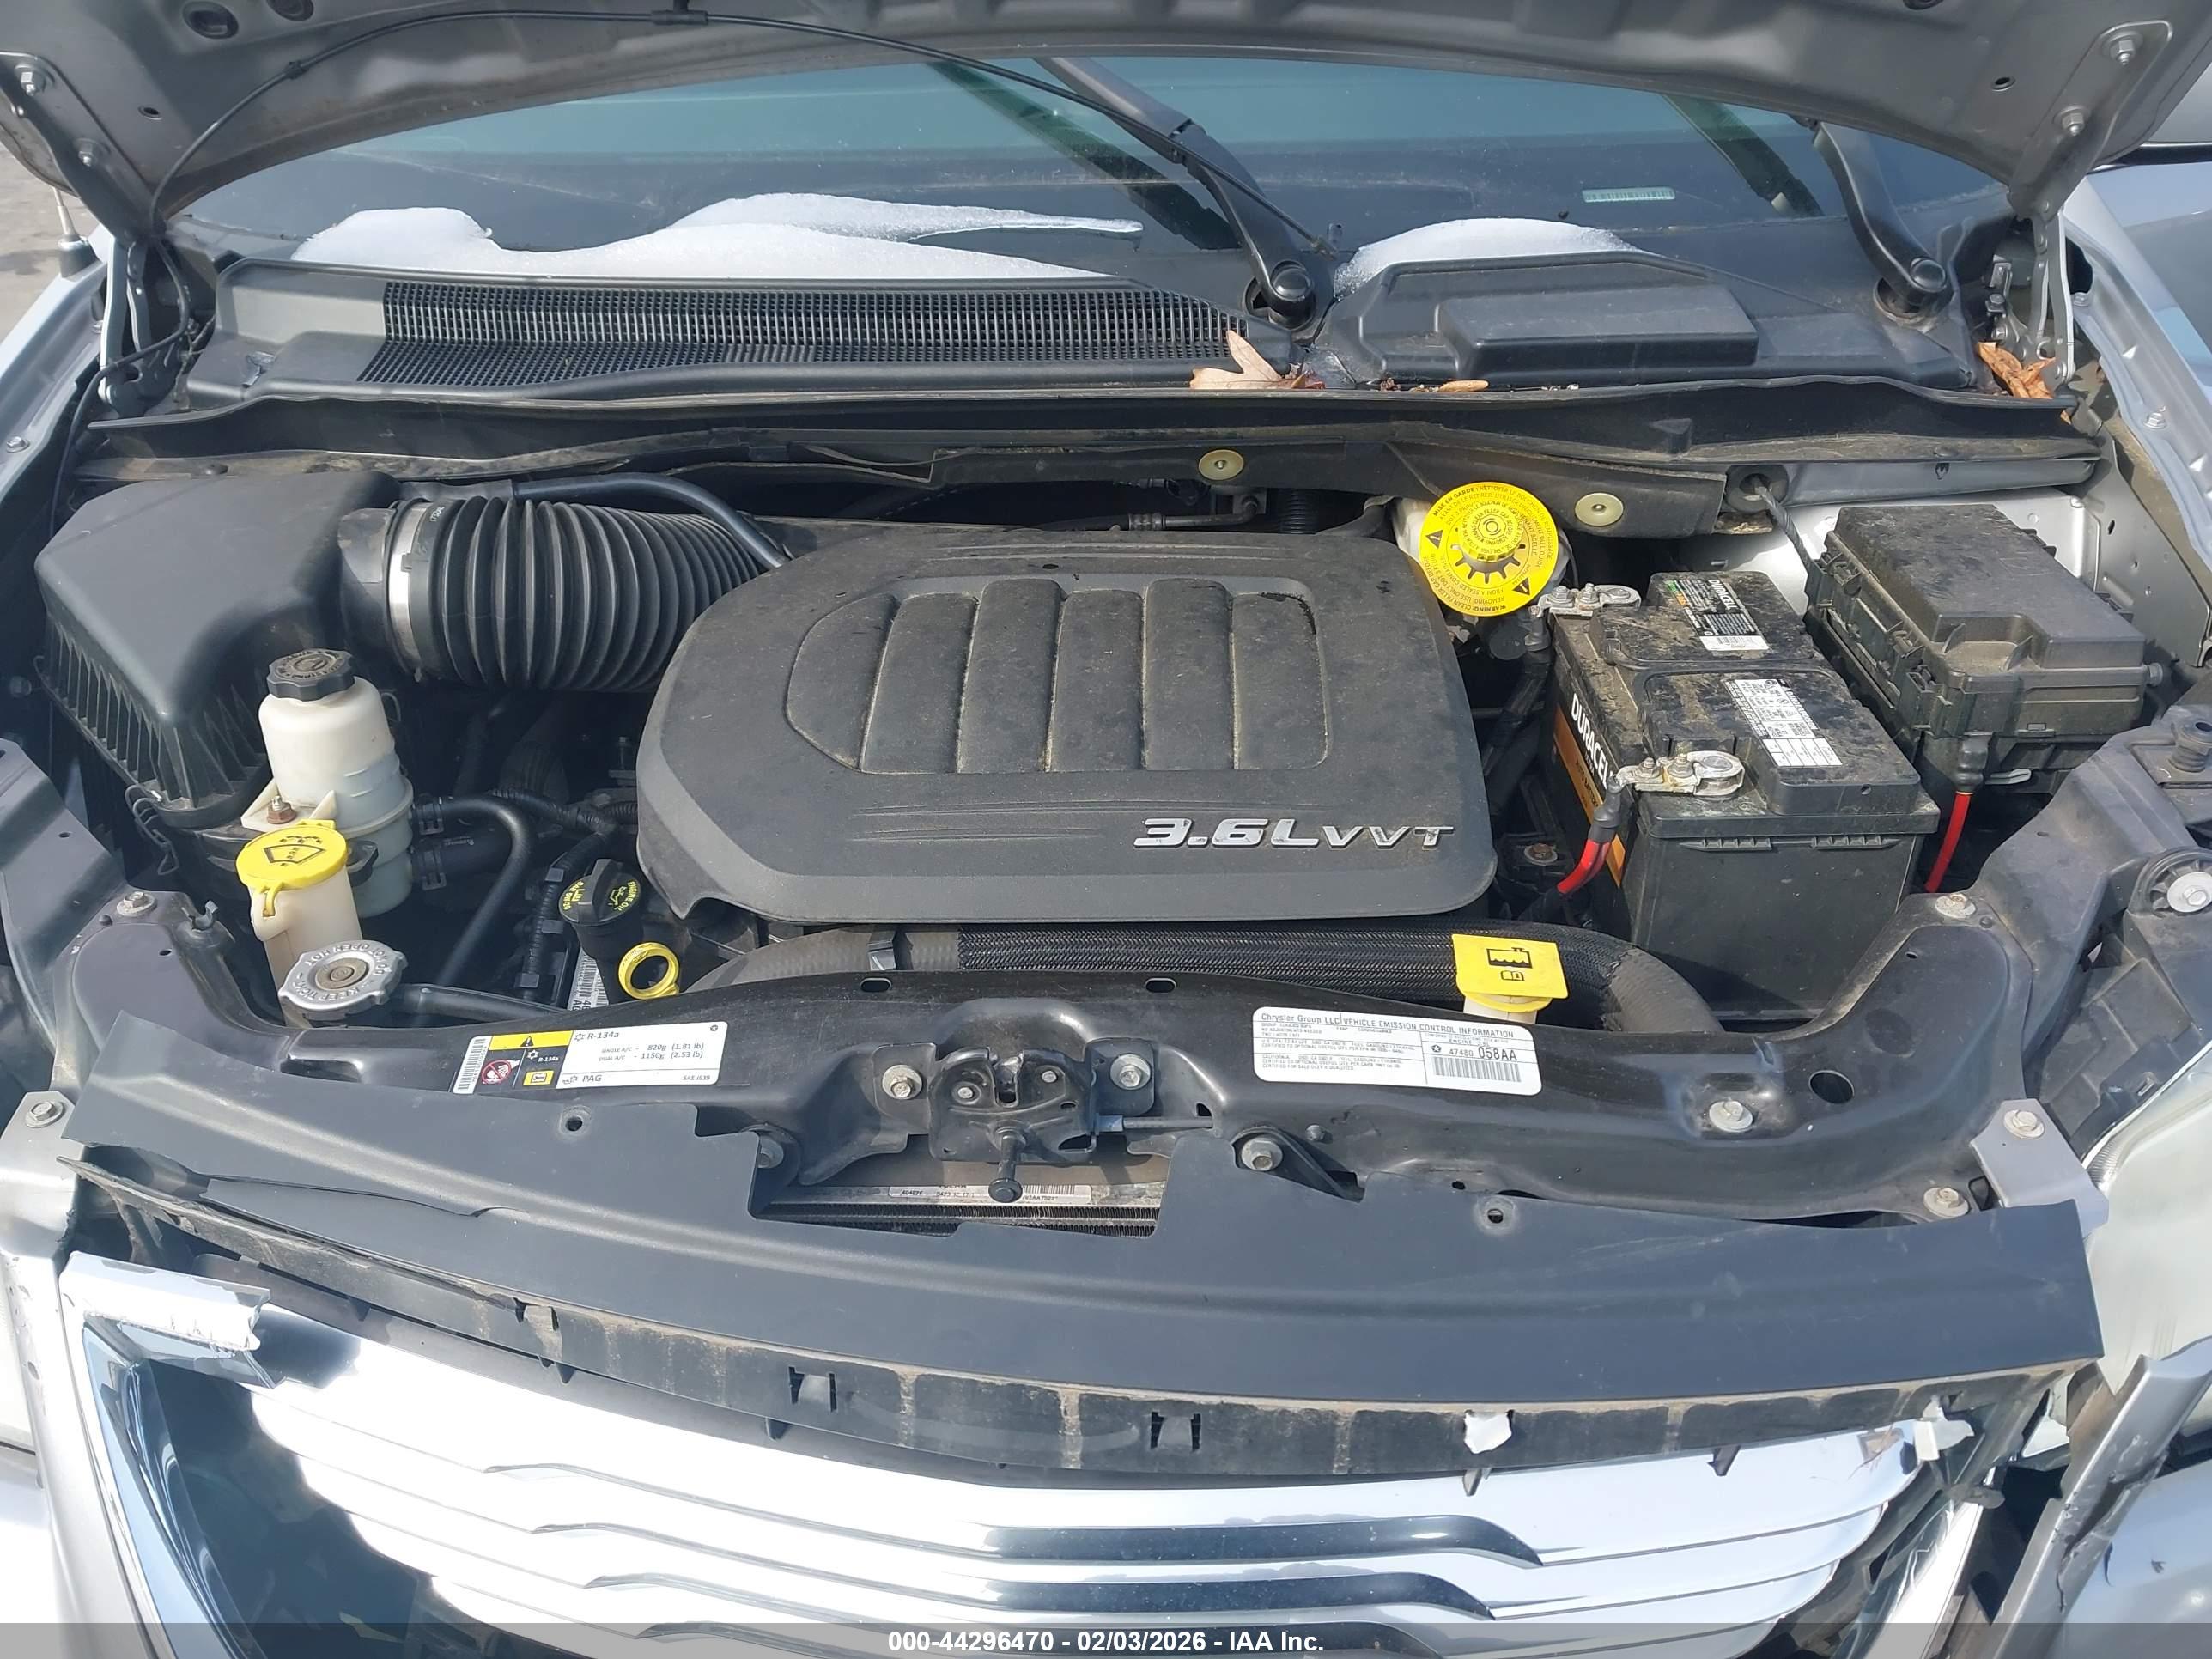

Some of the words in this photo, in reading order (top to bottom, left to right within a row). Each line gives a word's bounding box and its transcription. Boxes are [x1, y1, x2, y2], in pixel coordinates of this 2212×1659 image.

[1431, 578, 1440, 588] CAP
[1459, 583, 1480, 595] SEALED
[1437, 586, 1454, 601] FILLER
[1460, 594, 1472, 604] USE
[1708, 579, 1739, 610] DURACELL
[1454, 598, 1472, 611] CLEAN
[1473, 604, 1506, 612] WARNING:
[1571, 693, 1613, 789] DURACEL
[627, 881, 639, 904] ENGINE
[614, 902, 629, 912] OIL
[333, 944, 370, 953] OPEN
[305, 949, 330, 966] HOT
[319, 988, 360, 1000] KEEP
[1261, 1013, 1294, 1022] Chrysler
[1297, 1015, 1322, 1024] Group
[1344, 1018, 1376, 1027] VEHICLE
[1379, 1021, 1417, 1030] EMISSION
[1419, 1024, 1456, 1034] CONTROL
[1459, 1027, 1514, 1038] INFORMATION
[587, 1031, 620, 1040] R-134a
[1449, 1048, 1474, 1057] 47480
[1478, 1047, 1517, 1061] 058AA
